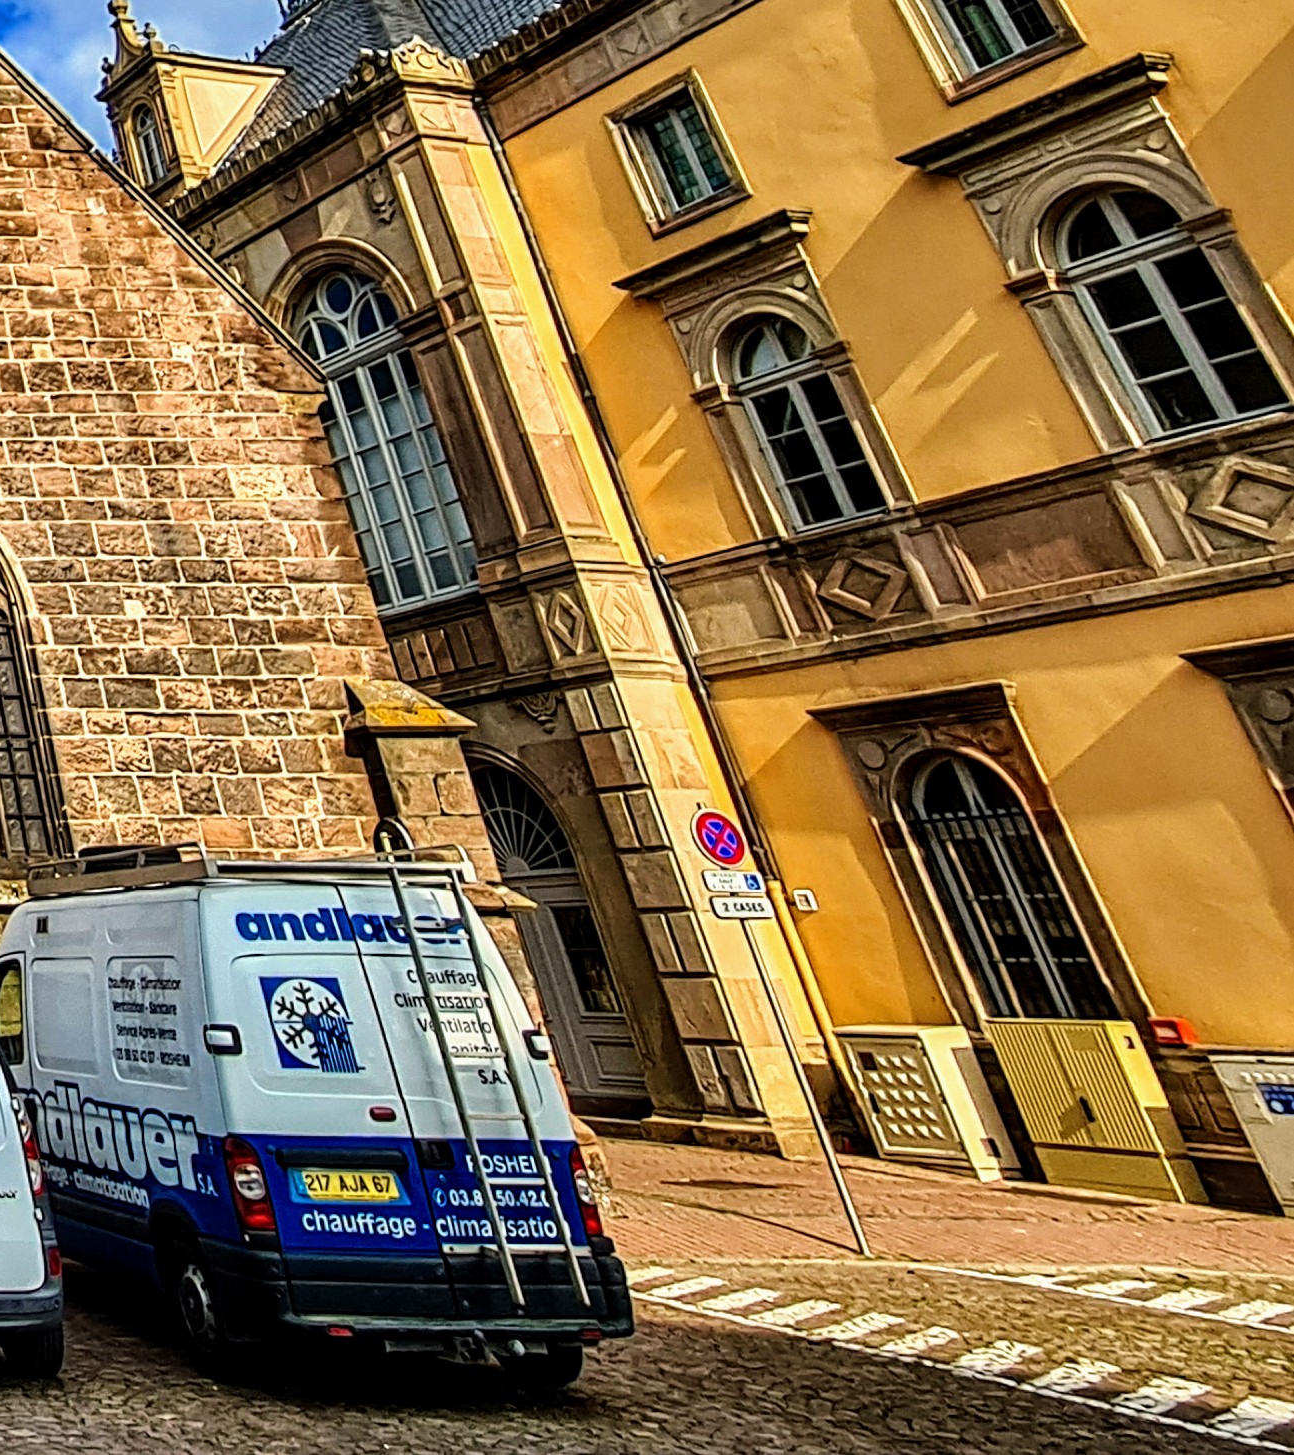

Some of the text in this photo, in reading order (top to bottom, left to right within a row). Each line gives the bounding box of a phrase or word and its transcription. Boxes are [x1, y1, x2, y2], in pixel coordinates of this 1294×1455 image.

[722, 902, 765, 913] 2 CASES
[406, 969, 483, 987] Cauffag
[19, 1079, 199, 1192] ndlauer
[307, 1174, 391, 1194] 217 AJA 67
[302, 1209, 417, 1239] chauffage
[436, 1215, 572, 1239] climaisatio
